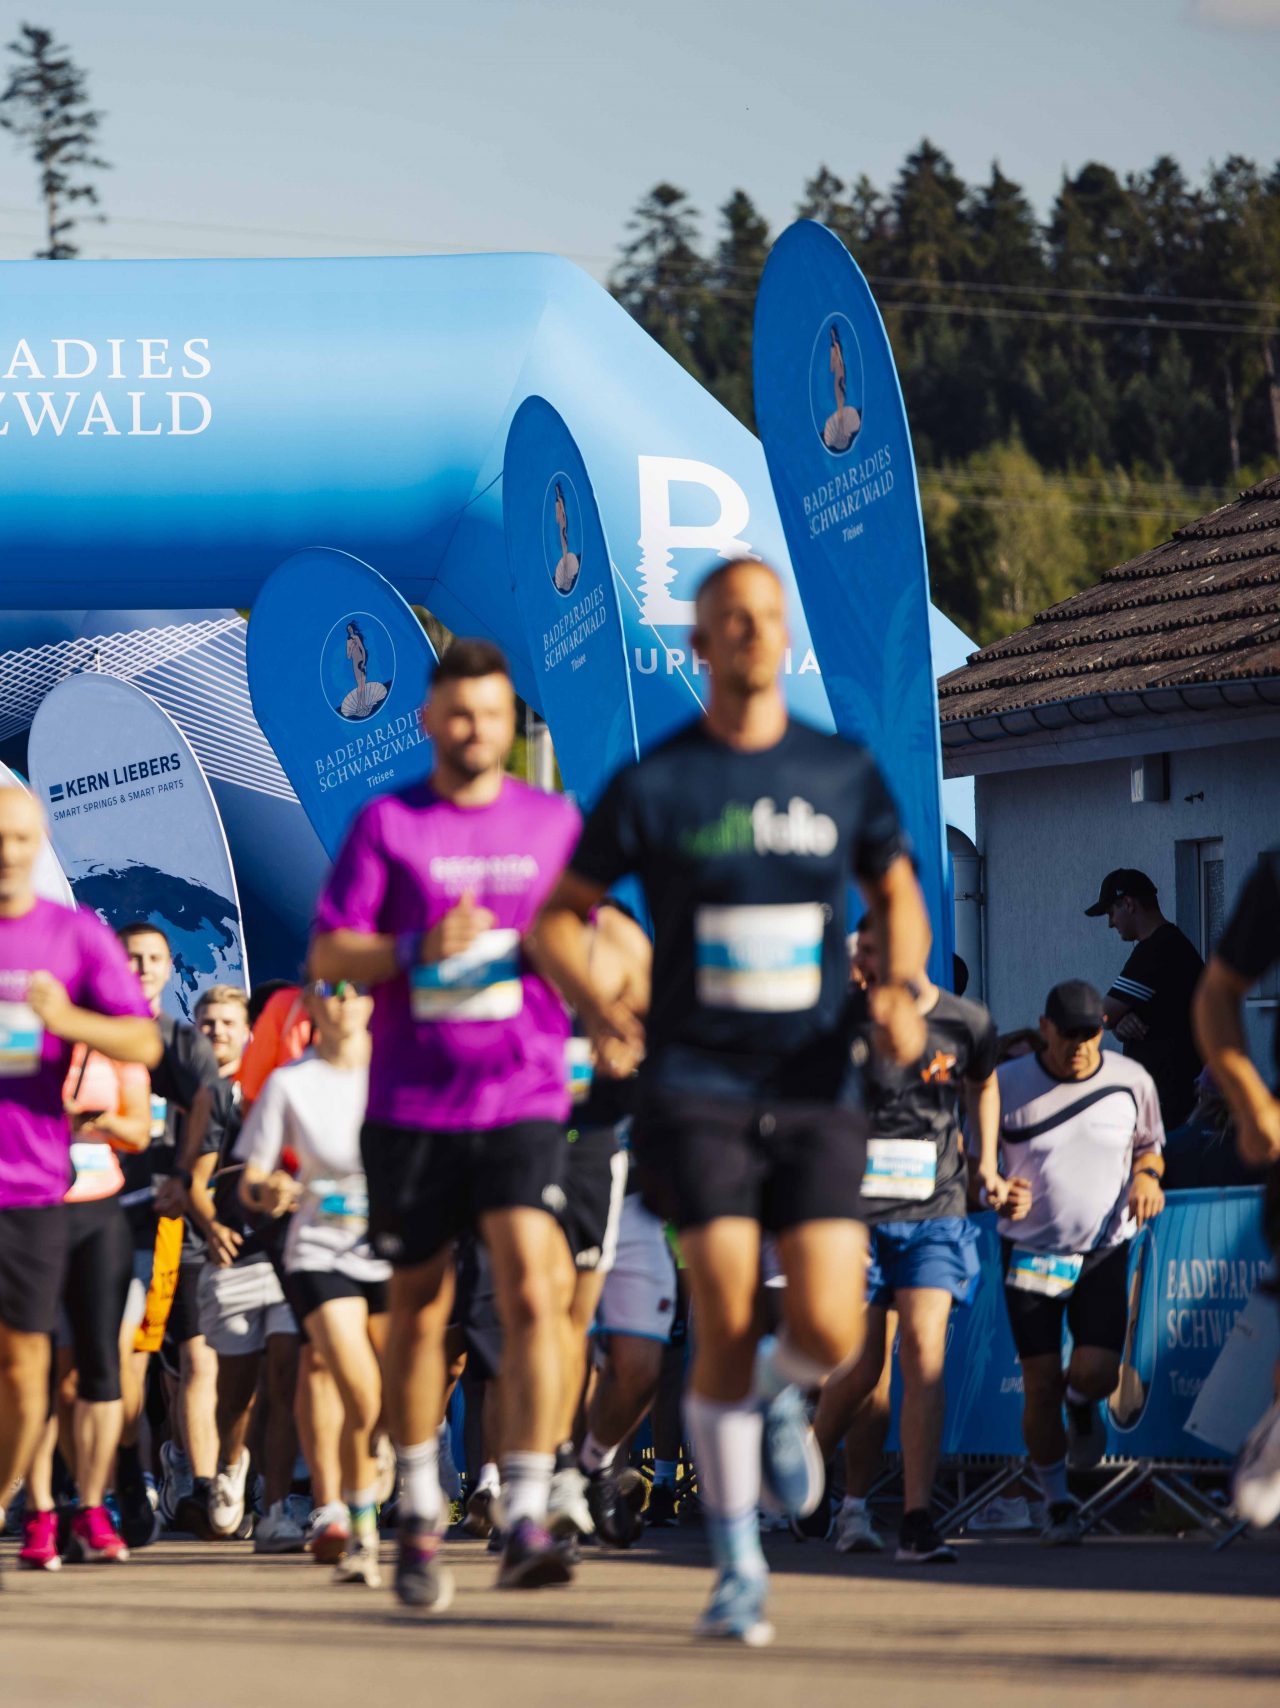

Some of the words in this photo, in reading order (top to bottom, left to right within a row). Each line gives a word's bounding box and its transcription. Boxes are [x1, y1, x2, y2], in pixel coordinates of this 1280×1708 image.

[542, 584, 604, 651] BADEPARADIES
[544, 606, 606, 672] SCHWARZWALD
[53, 805, 81, 821] SMART
[83, 796, 118, 813] SPRINGS
[127, 786, 155, 801] SMART
[158, 779, 184, 793] PARTS
[65, 770, 110, 798] KERN
[113, 753, 181, 786] LIEBERS
